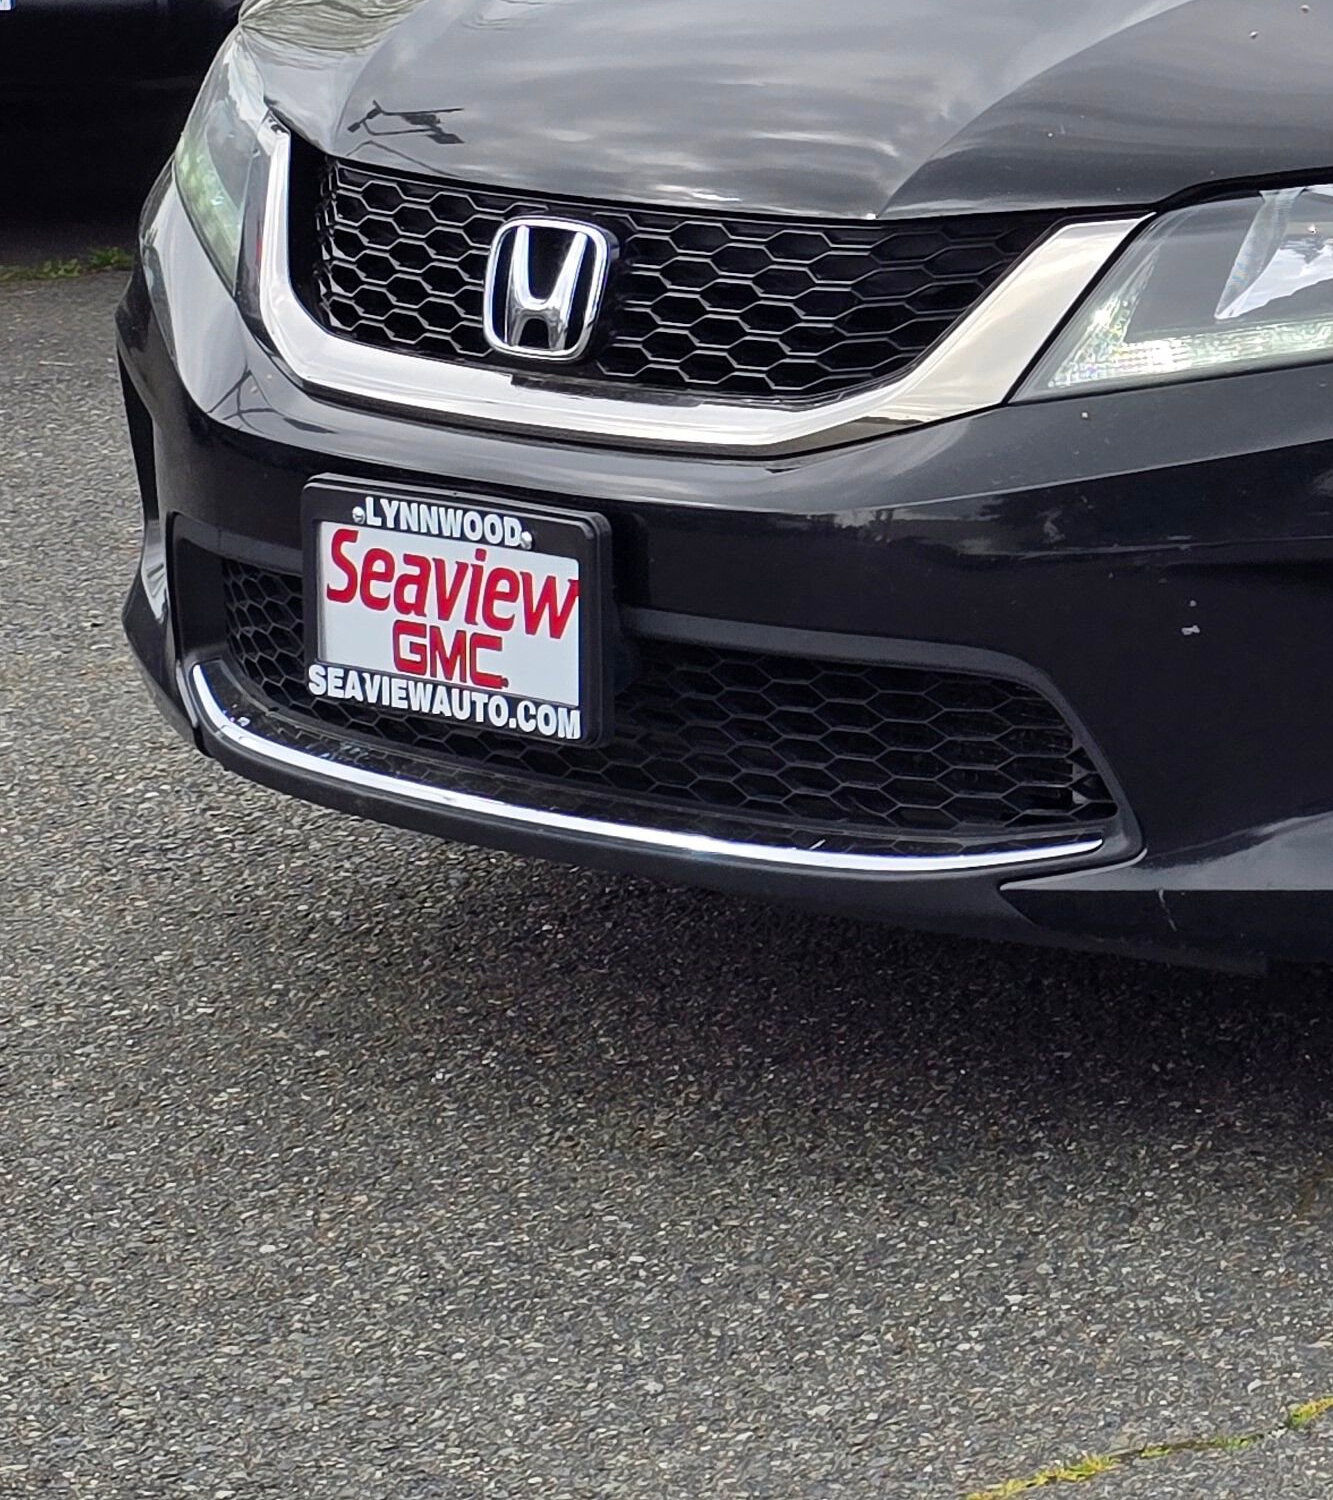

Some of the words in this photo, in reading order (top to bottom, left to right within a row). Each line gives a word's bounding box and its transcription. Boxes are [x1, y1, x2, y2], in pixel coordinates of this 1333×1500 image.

[364, 496, 523, 548] LYNNWOOD
[326, 528, 581, 640] Seaview
[392, 619, 504, 689] GMC
[308, 664, 582, 740] SEAVIEWAUTO.COM
